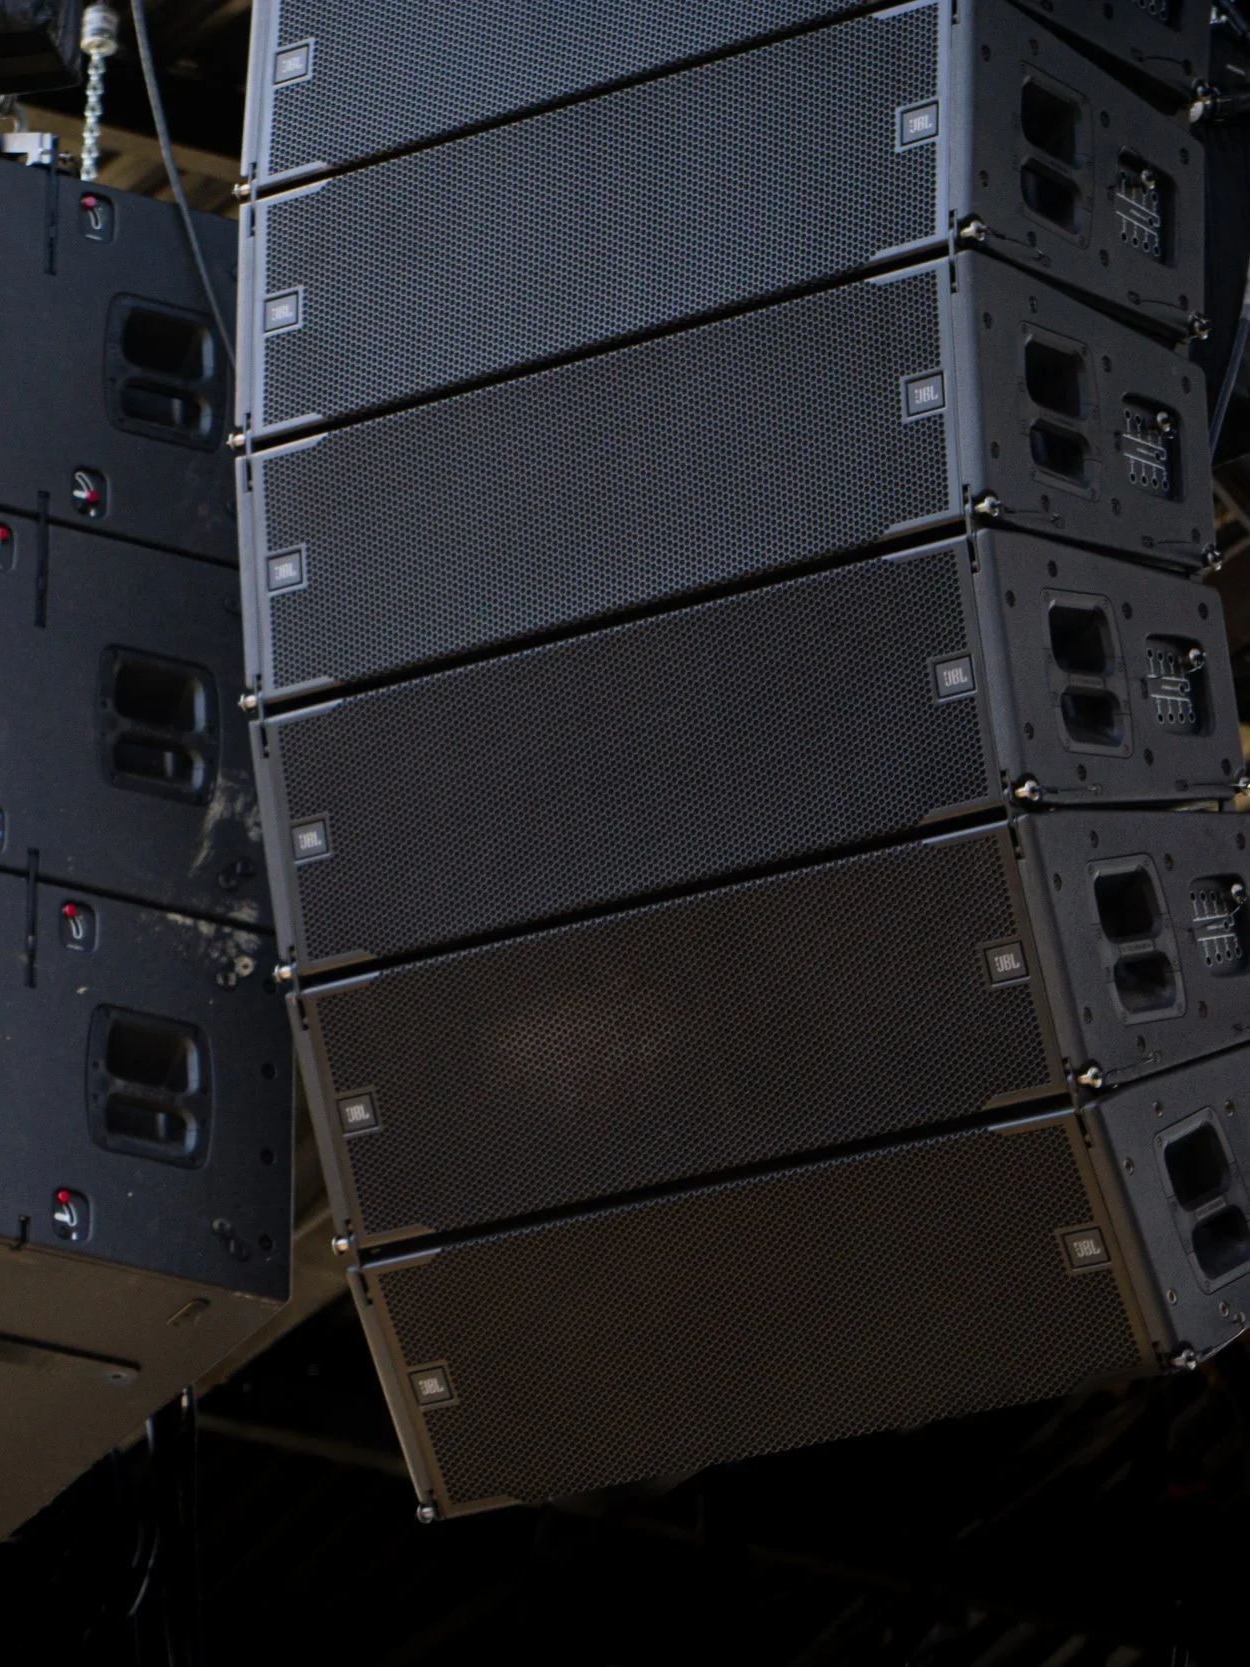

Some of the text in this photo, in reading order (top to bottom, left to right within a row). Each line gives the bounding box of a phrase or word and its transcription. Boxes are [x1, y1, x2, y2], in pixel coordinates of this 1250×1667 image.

[909, 115, 932, 133] JBL
[914, 385, 938, 404] JBL
[274, 563, 297, 580] JBL
[943, 667, 968, 686] JBL
[299, 831, 322, 849] JBL
[994, 953, 1020, 972] JBL
[345, 1104, 370, 1123] JBL
[1074, 1240, 1100, 1258] JBL
[418, 1378, 444, 1396] JBL
